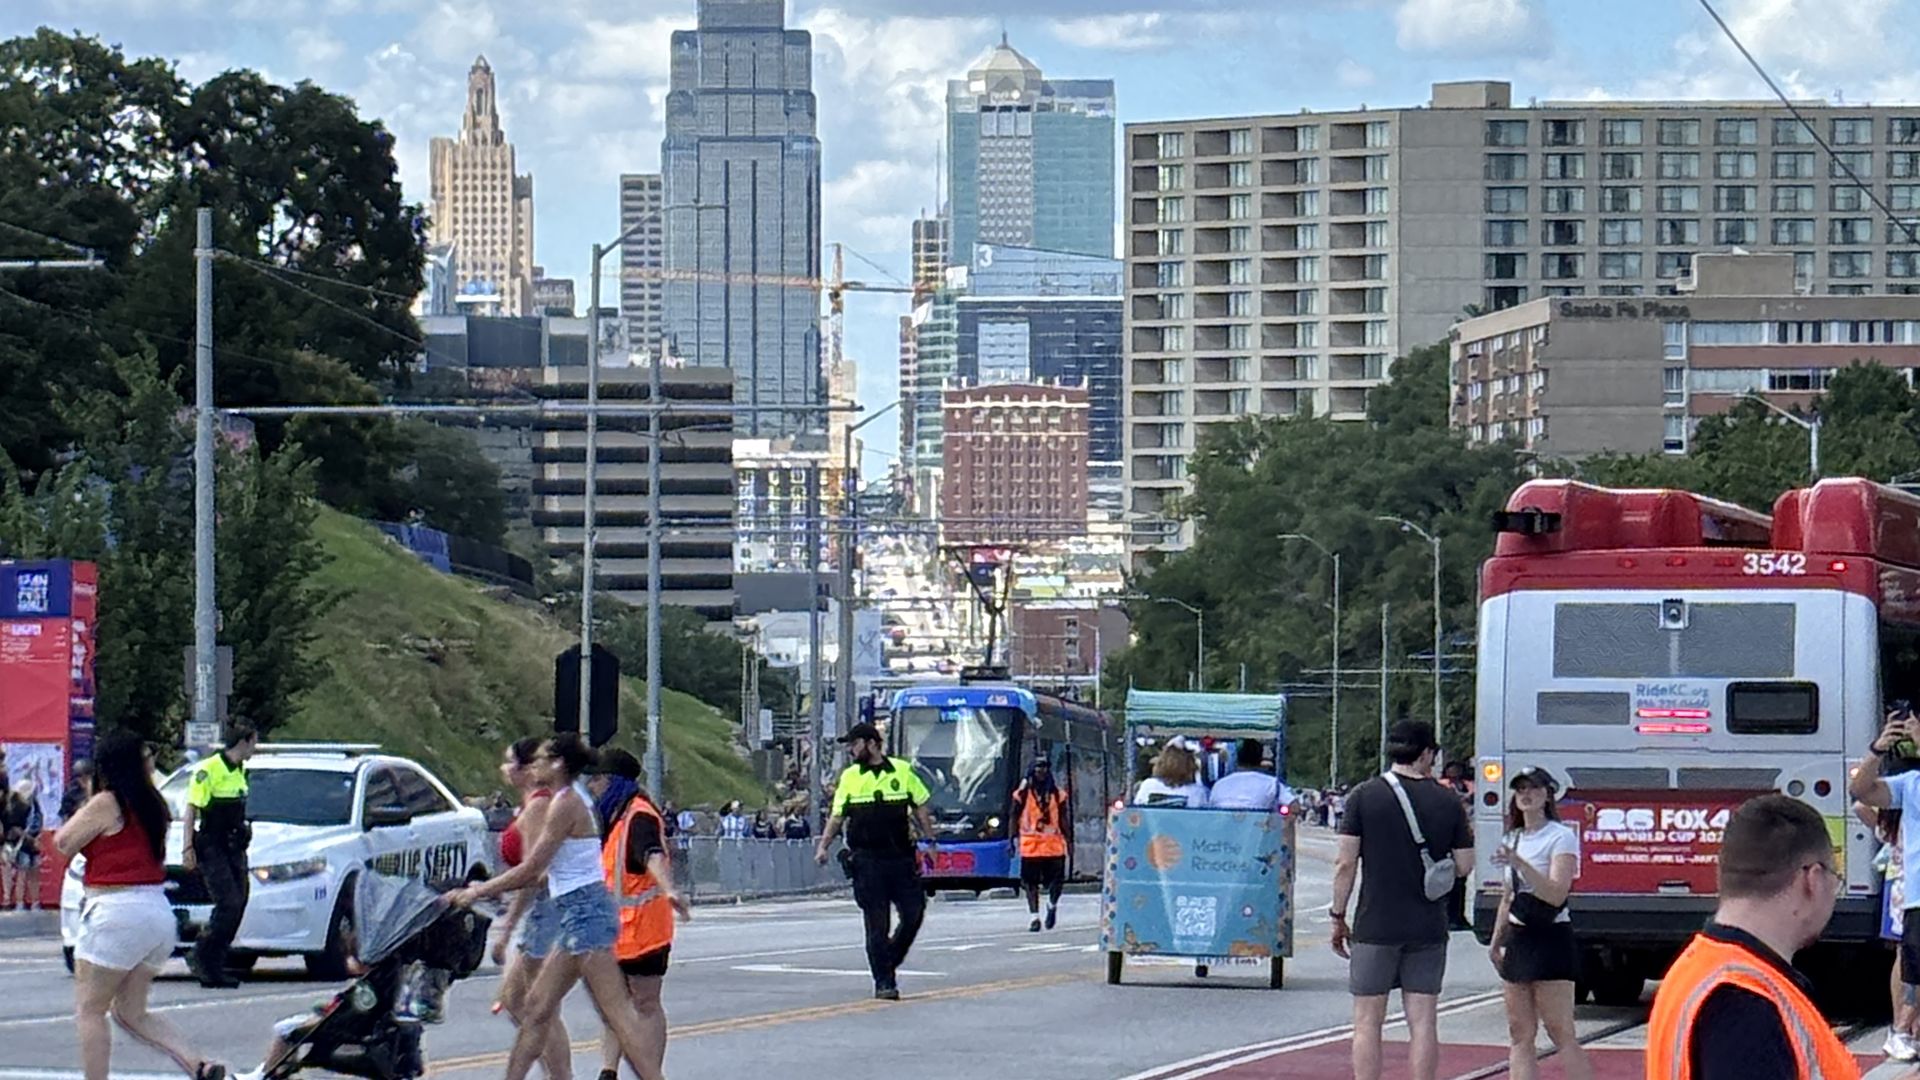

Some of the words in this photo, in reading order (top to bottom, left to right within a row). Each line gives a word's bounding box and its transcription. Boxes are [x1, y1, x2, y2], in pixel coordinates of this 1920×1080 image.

[978, 244, 993, 267] 3
[1560, 302, 1613, 318] Santa
[1616, 301, 1638, 318] Fe
[1643, 301, 1691, 318] Place
[1742, 553, 1806, 575] 3542
[1584, 831, 1614, 843] FIFA
[1616, 831, 1666, 843] WORLD
[1668, 831, 1696, 843] CUP
